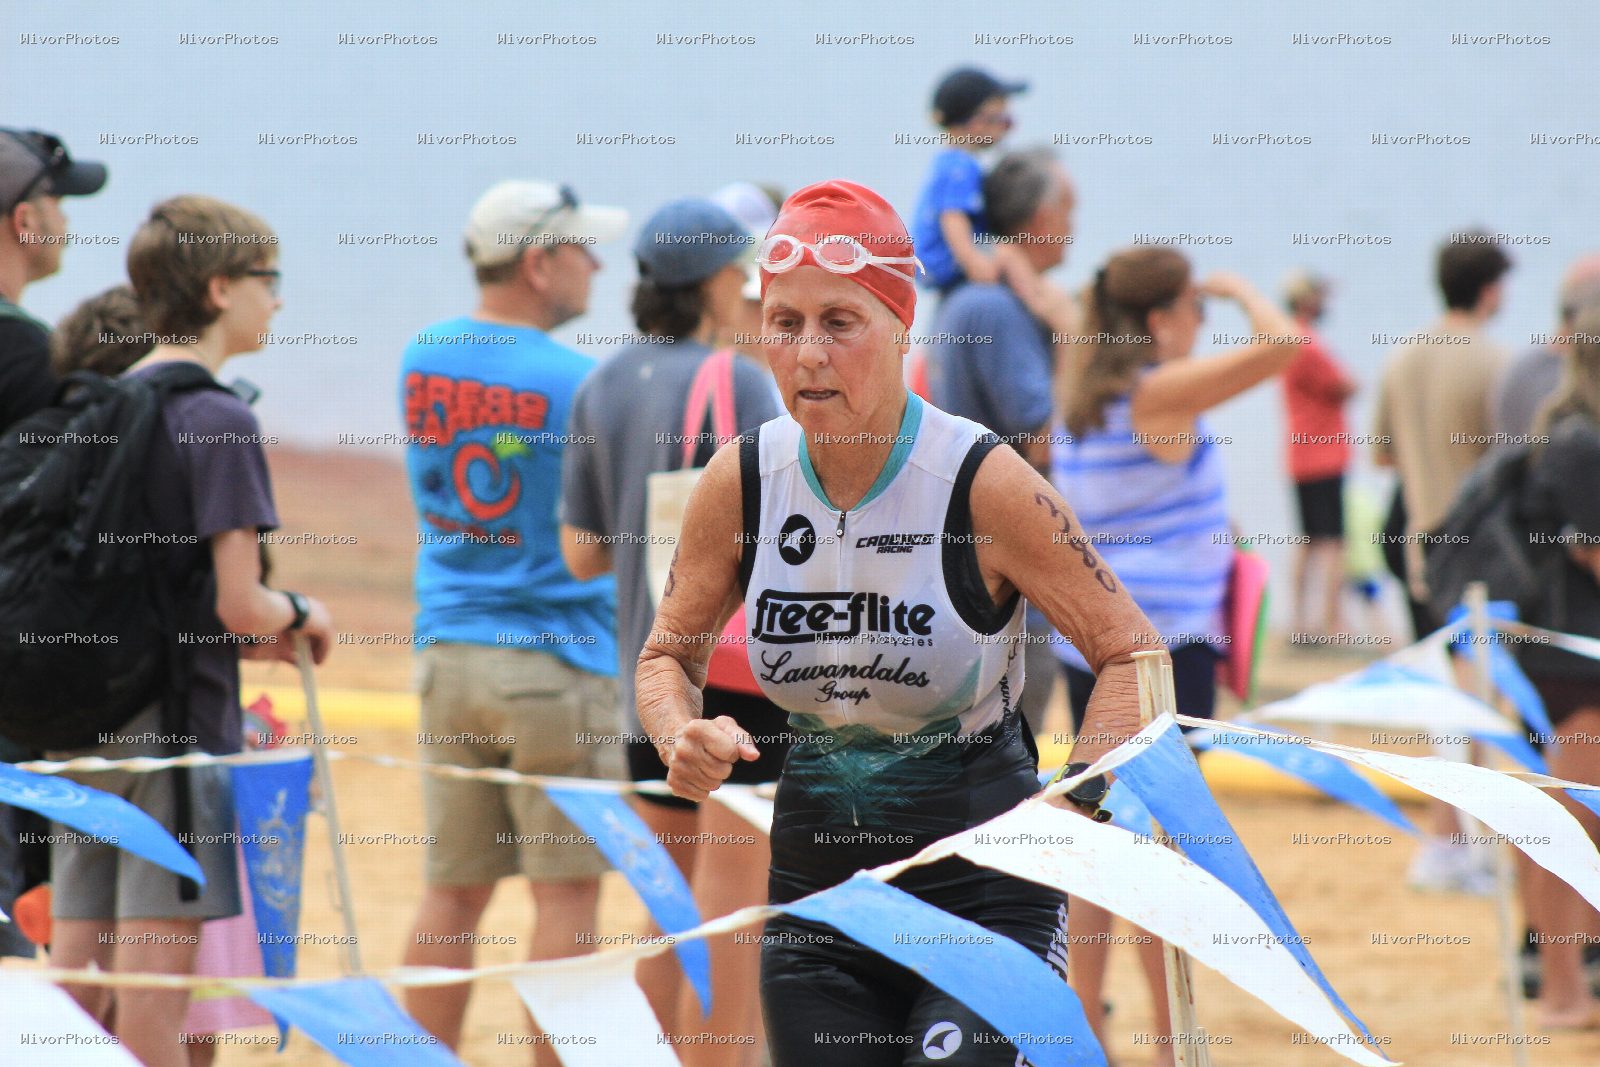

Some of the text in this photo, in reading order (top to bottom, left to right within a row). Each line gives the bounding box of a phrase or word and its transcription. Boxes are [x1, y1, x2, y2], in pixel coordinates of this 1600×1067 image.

[876, 546, 914, 554] RACING
[751, 589, 936, 643] free-flite
[760, 650, 930, 688] Lawandales
[815, 681, 872, 706] Group
